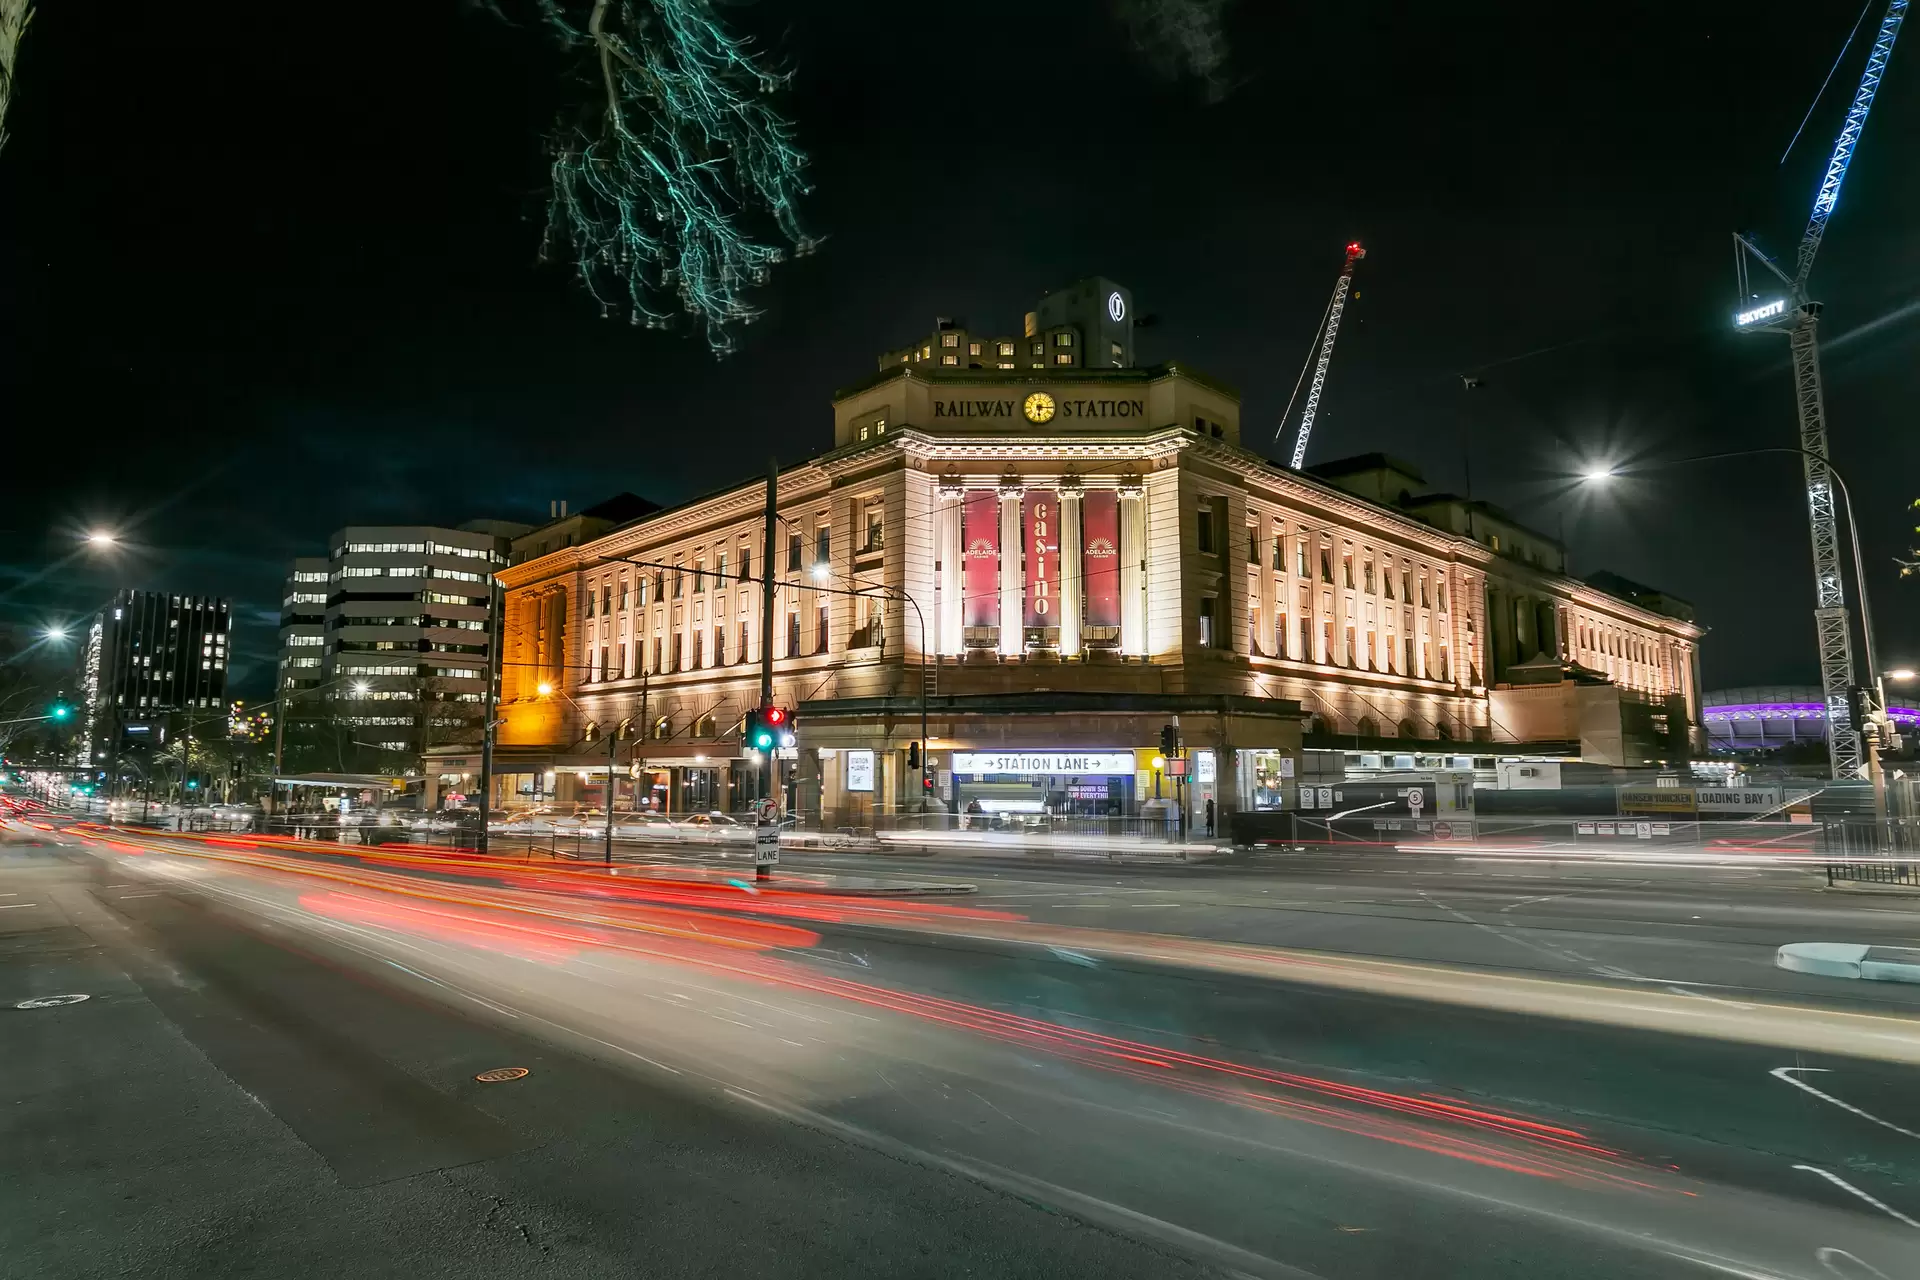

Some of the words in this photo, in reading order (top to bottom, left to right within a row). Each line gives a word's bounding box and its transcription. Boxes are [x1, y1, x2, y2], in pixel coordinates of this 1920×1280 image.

[1738, 300, 1784, 325] SKYCITY
[934, 400, 1015, 417] RAILWAY
[1063, 400, 1144, 417] STATION
[1034, 503, 1049, 615] casino
[997, 757, 1051, 770] STATION
[1057, 757, 1089, 770] LANE
[1697, 793, 1741, 804] LOADING
[1745, 793, 1764, 805] BAY
[1768, 793, 1773, 805] 1
[757, 850, 778, 861] LANE
